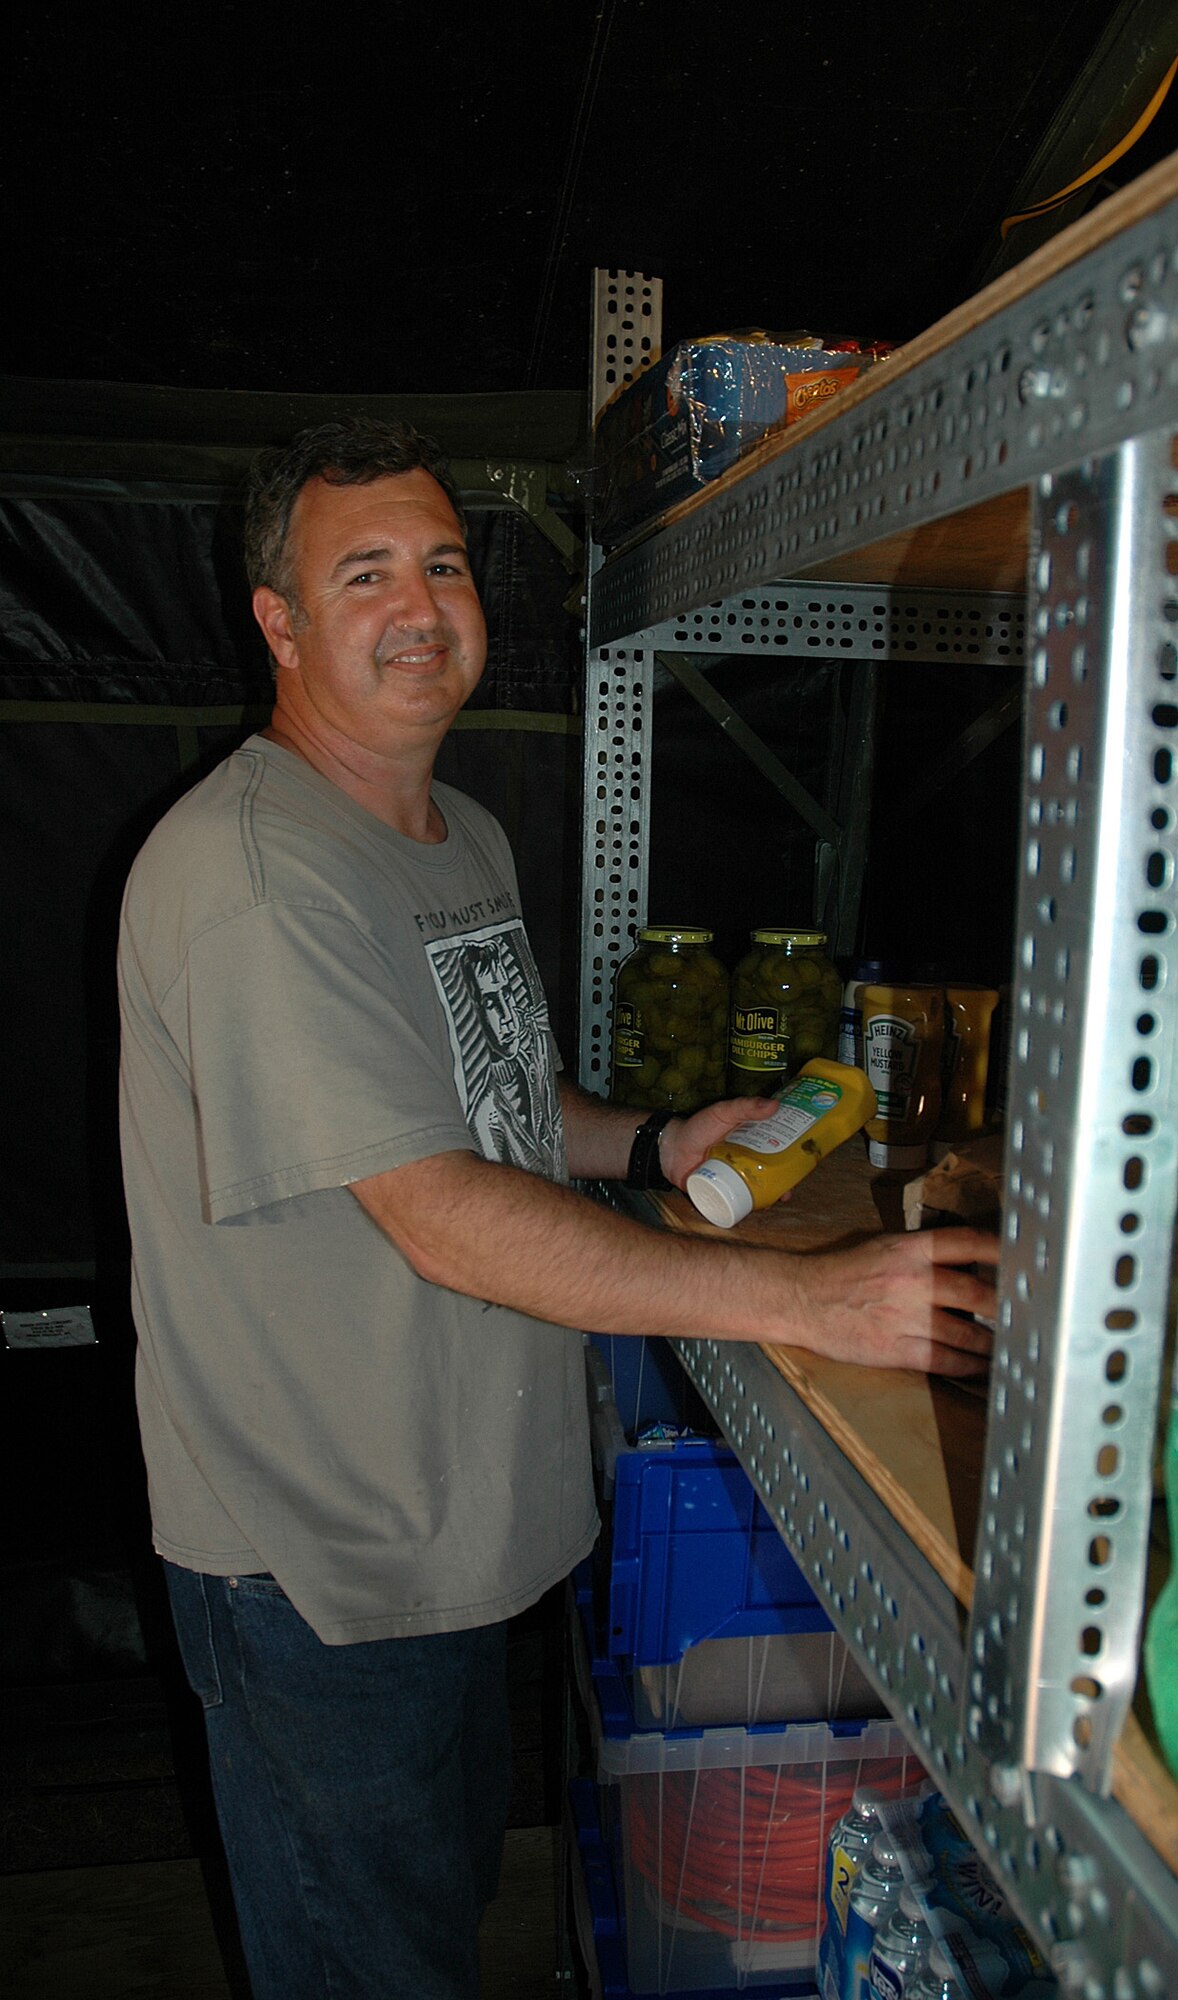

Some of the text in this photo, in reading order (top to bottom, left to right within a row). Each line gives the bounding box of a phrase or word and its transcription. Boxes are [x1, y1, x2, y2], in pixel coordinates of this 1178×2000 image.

[448, 901, 486, 926] MUST
[746, 1012, 774, 1031] Olive
[874, 1024, 905, 1040] HEINZ
[746, 1048, 779, 1060] CHIPS
[872, 1046, 903, 1059] YELLOW
[870, 1057, 904, 1072] MUSTARD
[838, 1866, 849, 1897] 2
